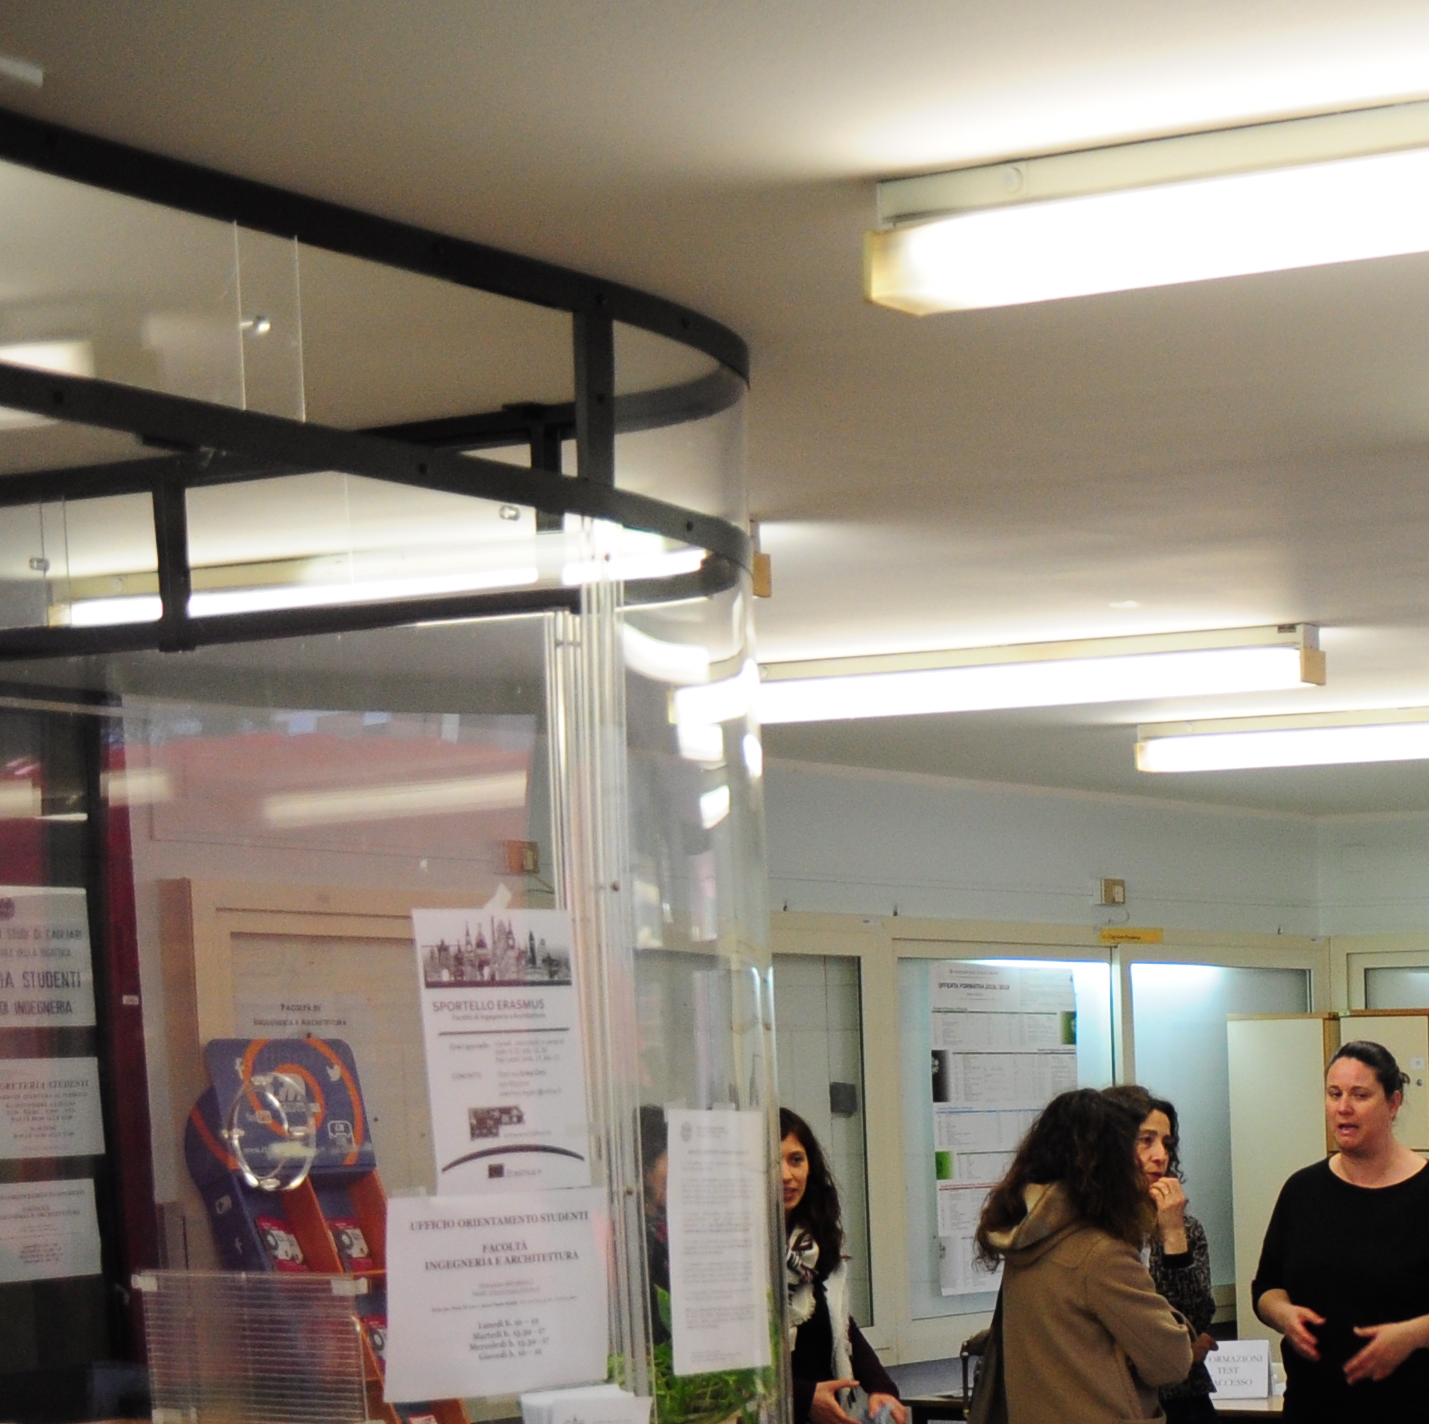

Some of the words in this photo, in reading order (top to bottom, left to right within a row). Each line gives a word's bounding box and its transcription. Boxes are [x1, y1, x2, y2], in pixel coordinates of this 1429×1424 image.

[22, 971, 81, 988] STUDENTI
[432, 1000, 495, 1012] SPORTELLO
[497, 998, 545, 1010] ERASMUS
[410, 1219, 455, 1231] UFFICIO
[457, 1213, 539, 1228] ORIENTAMENTO
[541, 1210, 589, 1222] STUDENTI
[425, 1256, 493, 1271] INGEGNERIA
[504, 1251, 579, 1265] ARCHITETTURA
[1208, 1354, 1263, 1363] ORMAZIONI
[1217, 1366, 1239, 1374] TEST
